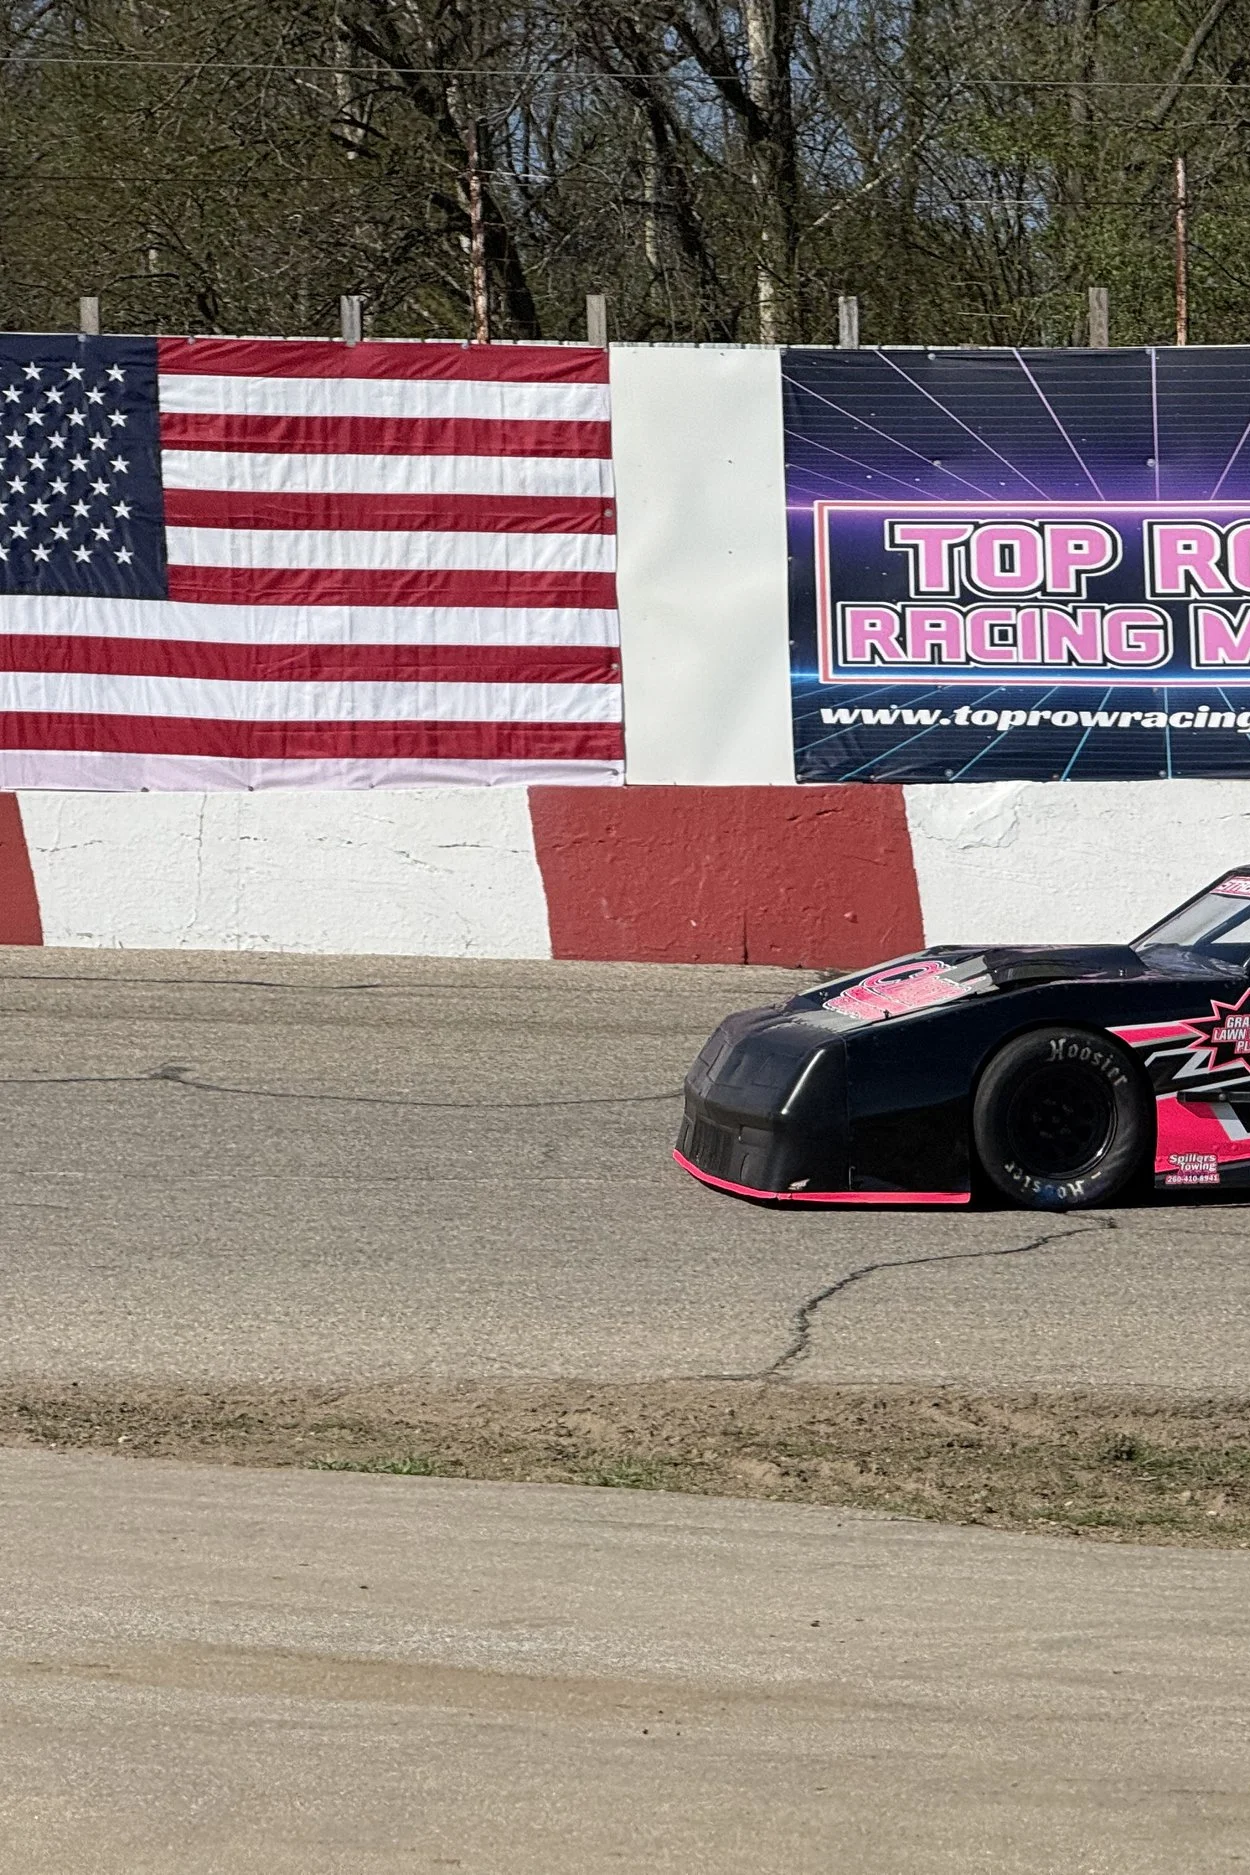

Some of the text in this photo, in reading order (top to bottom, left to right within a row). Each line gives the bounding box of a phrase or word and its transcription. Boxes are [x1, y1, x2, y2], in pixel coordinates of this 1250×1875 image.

[887, 519, 1120, 599] TOP
[840, 603, 1171, 668] RACING
[1213, 1027, 1246, 1041] LAWN
[1046, 1038, 1128, 1086] Hoosier
[1169, 1154, 1217, 1165] Spillers
[1180, 1161, 1217, 1173] Towing
